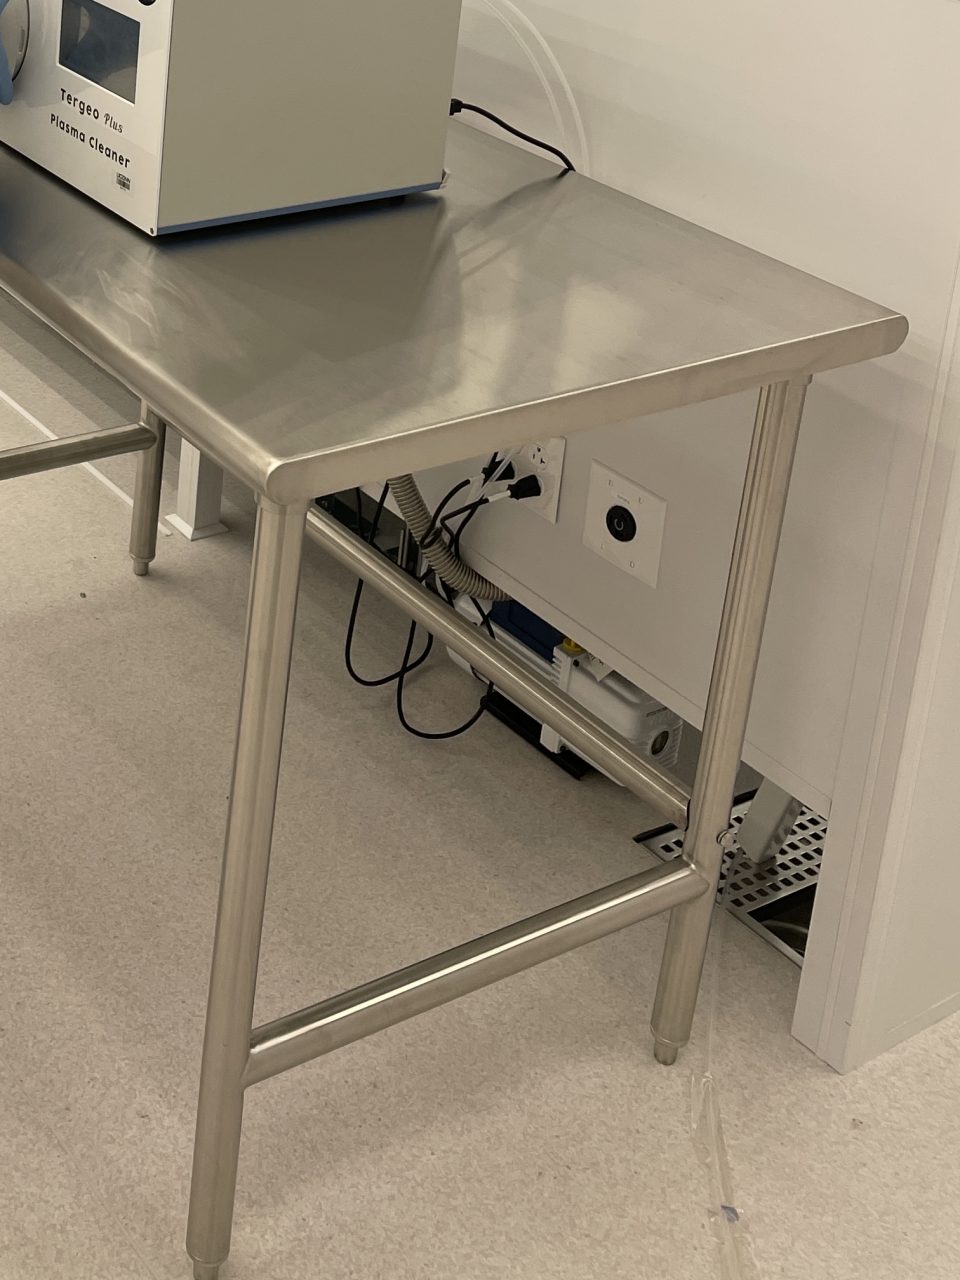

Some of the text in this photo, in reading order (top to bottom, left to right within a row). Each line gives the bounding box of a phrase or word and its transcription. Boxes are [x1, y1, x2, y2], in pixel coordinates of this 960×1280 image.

[60, 88, 124, 133] Tergeo Plus
[50, 113, 131, 168] Plasma Cleaner
